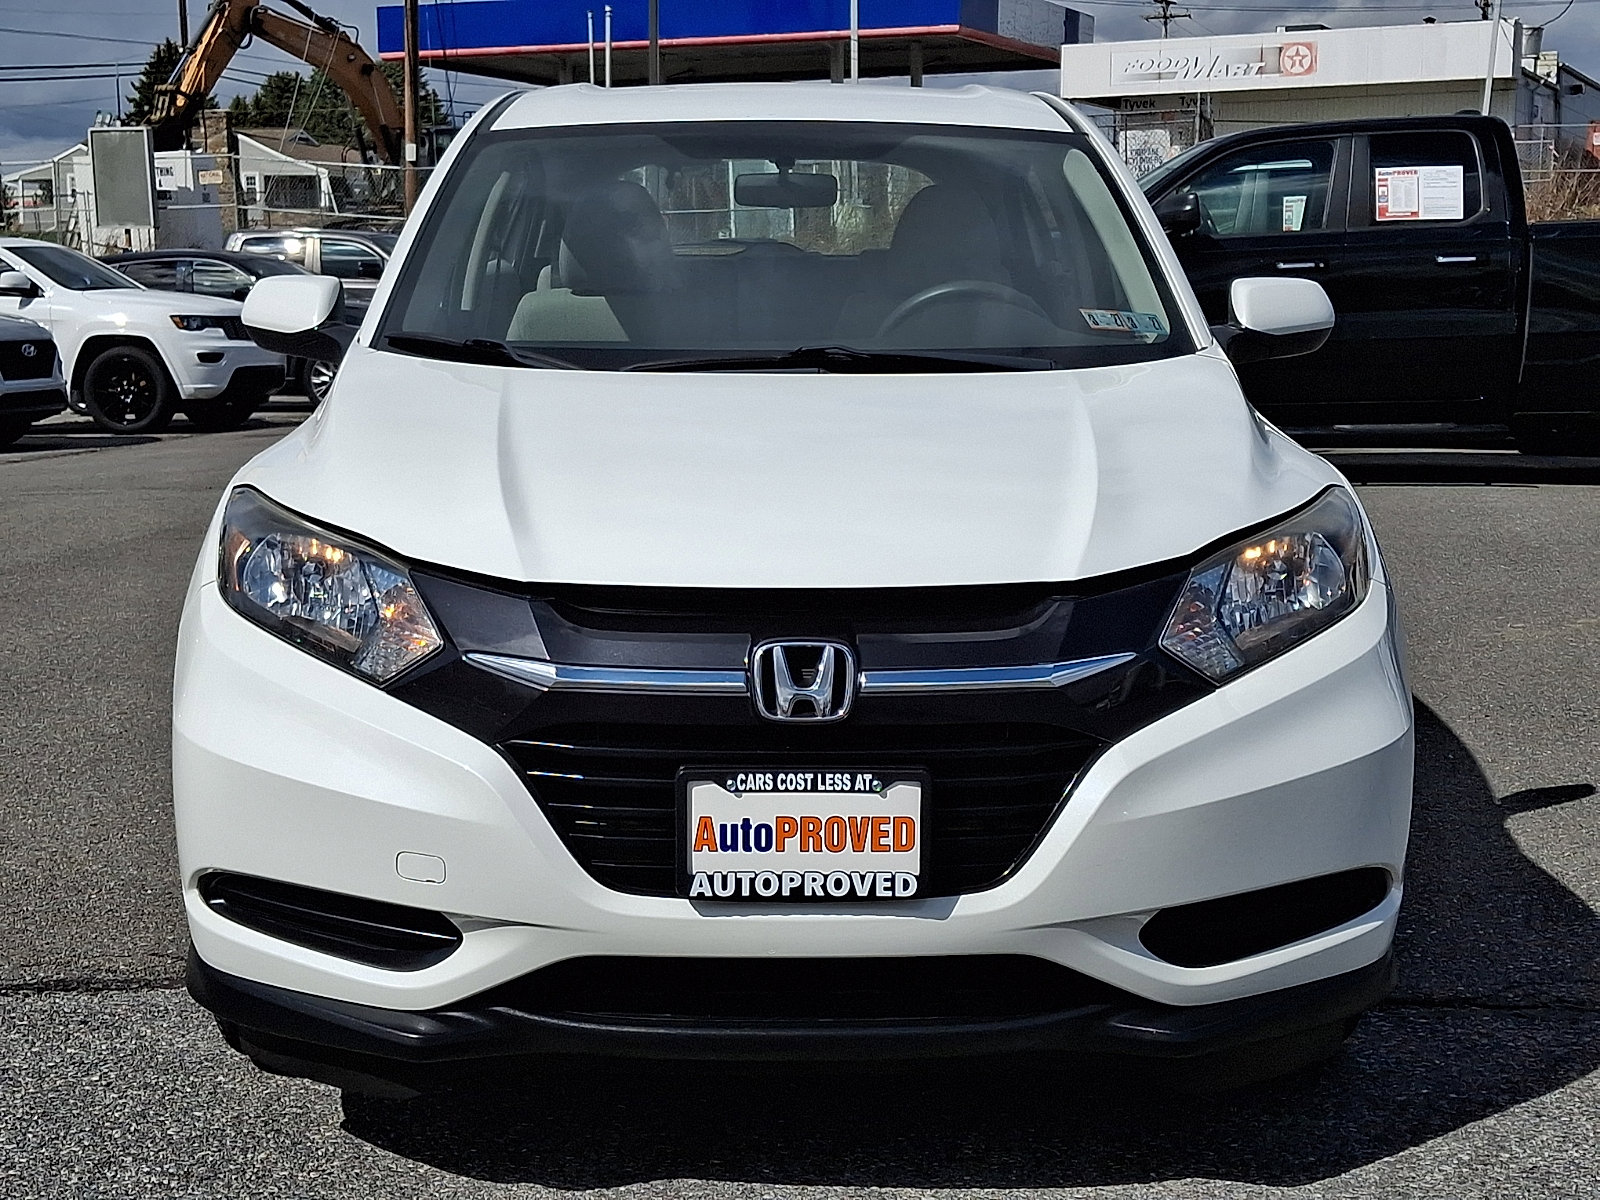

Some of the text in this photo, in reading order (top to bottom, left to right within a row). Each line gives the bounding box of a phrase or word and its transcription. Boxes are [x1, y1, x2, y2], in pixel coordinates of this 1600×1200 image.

[1122, 98, 1156, 110] Tyvek
[736, 773, 873, 791] CARS COST LESS AT
[693, 815, 917, 853] AutoPROVED
[689, 871, 918, 897] AUTOPROVED
